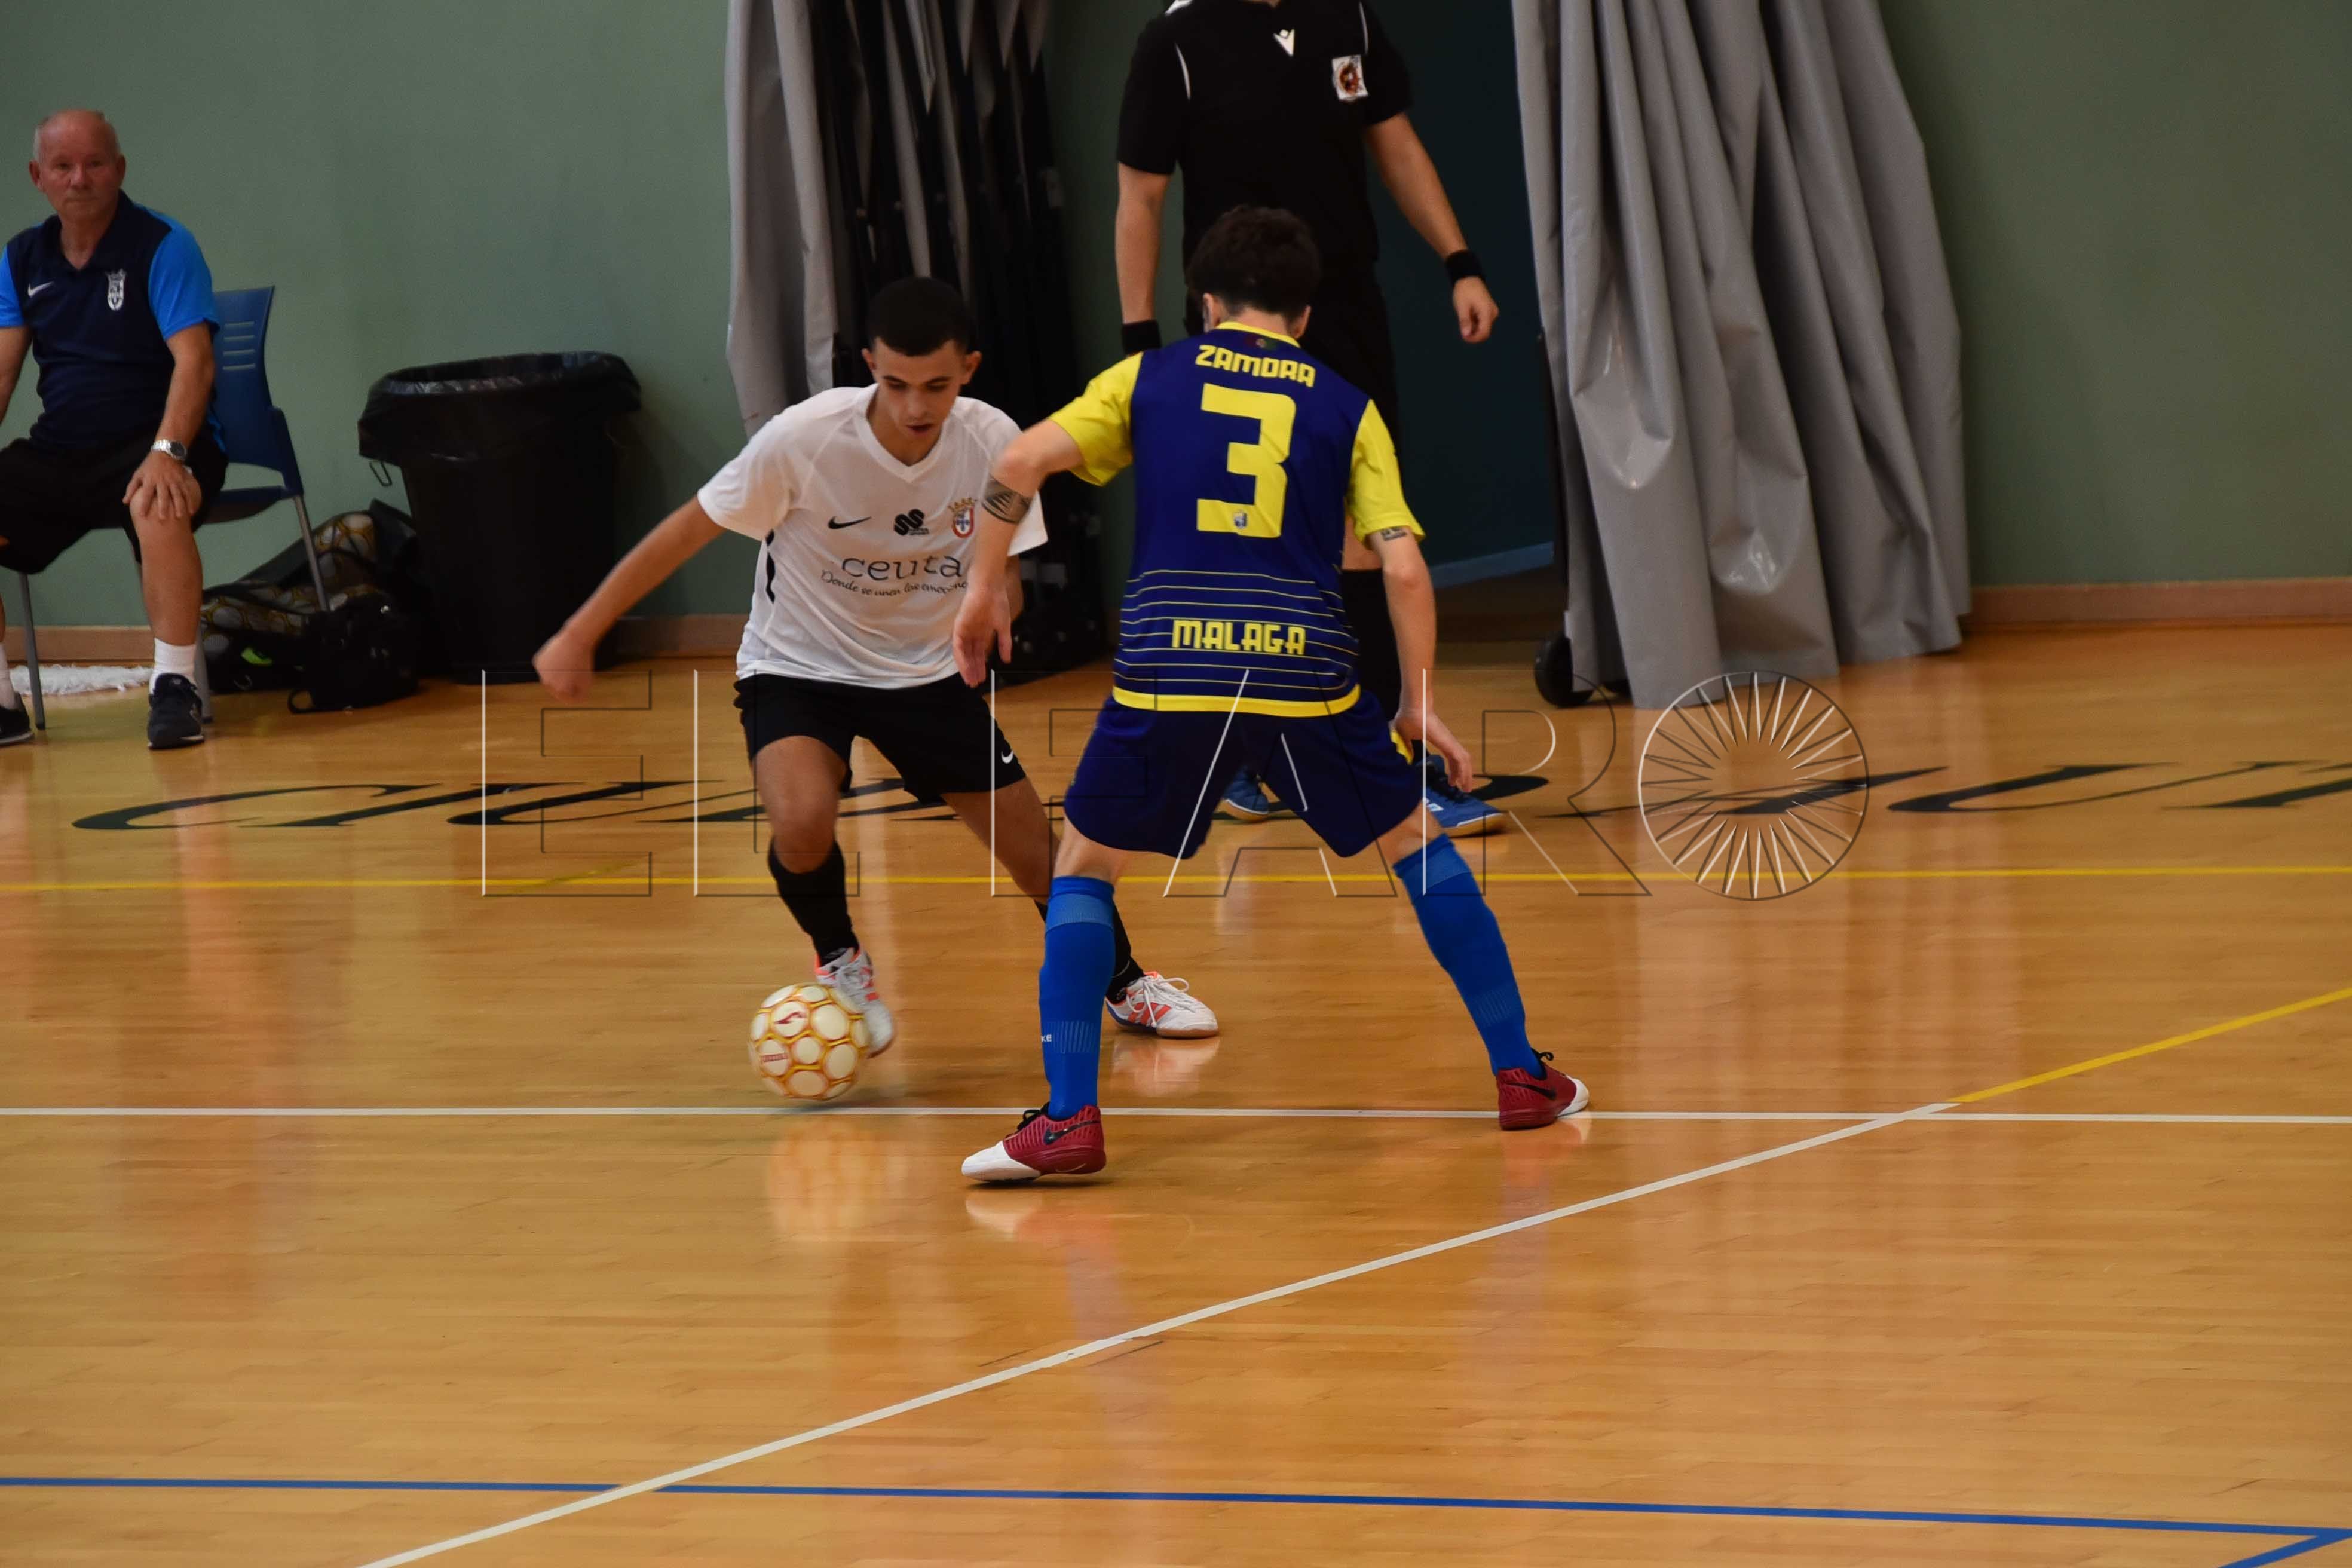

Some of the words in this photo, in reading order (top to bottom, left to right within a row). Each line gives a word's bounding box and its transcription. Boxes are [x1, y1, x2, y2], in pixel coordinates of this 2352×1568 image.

[1196, 344, 1315, 387] ZAMORA
[1196, 383, 1296, 538] 3
[821, 569, 859, 592] Donde
[841, 555, 962, 581] ceuta
[1172, 619, 1306, 655] MALAGA
